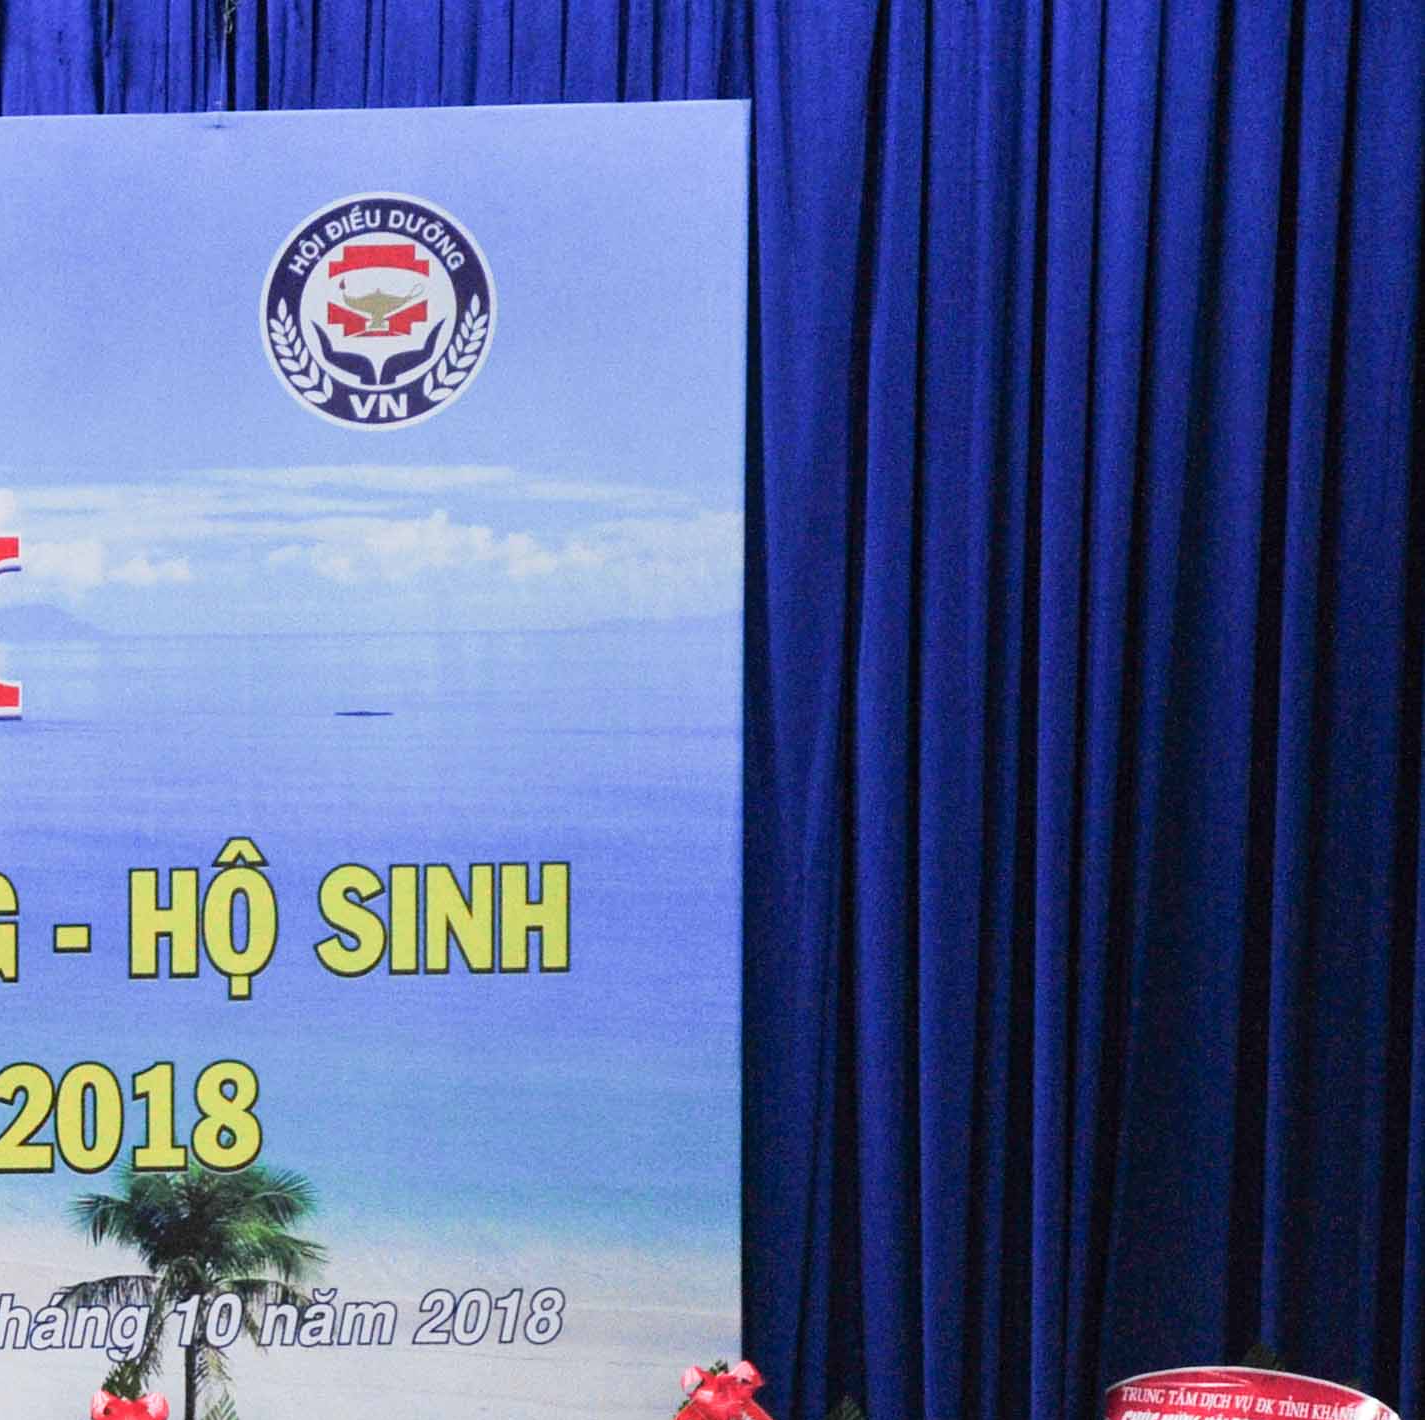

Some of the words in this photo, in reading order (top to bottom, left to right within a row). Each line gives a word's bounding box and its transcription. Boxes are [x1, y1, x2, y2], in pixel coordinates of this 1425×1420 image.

[289, 232, 325, 276] HỘI
[349, 393, 408, 418] VN
[50, 925, 91, 954] -
[127, 837, 278, 1000] HỘ
[314, 862, 571, 977] SINH
[170, 1294, 235, 1347] 10
[259, 1290, 392, 1347] năm
[412, 1288, 564, 1346] 2018
[1121, 1386, 1164, 1404] TRUNG
[1198, 1392, 1232, 1413] DỊCH
[1234, 1396, 1252, 1414] VỤ
[1255, 1397, 1274, 1414] ĐK
